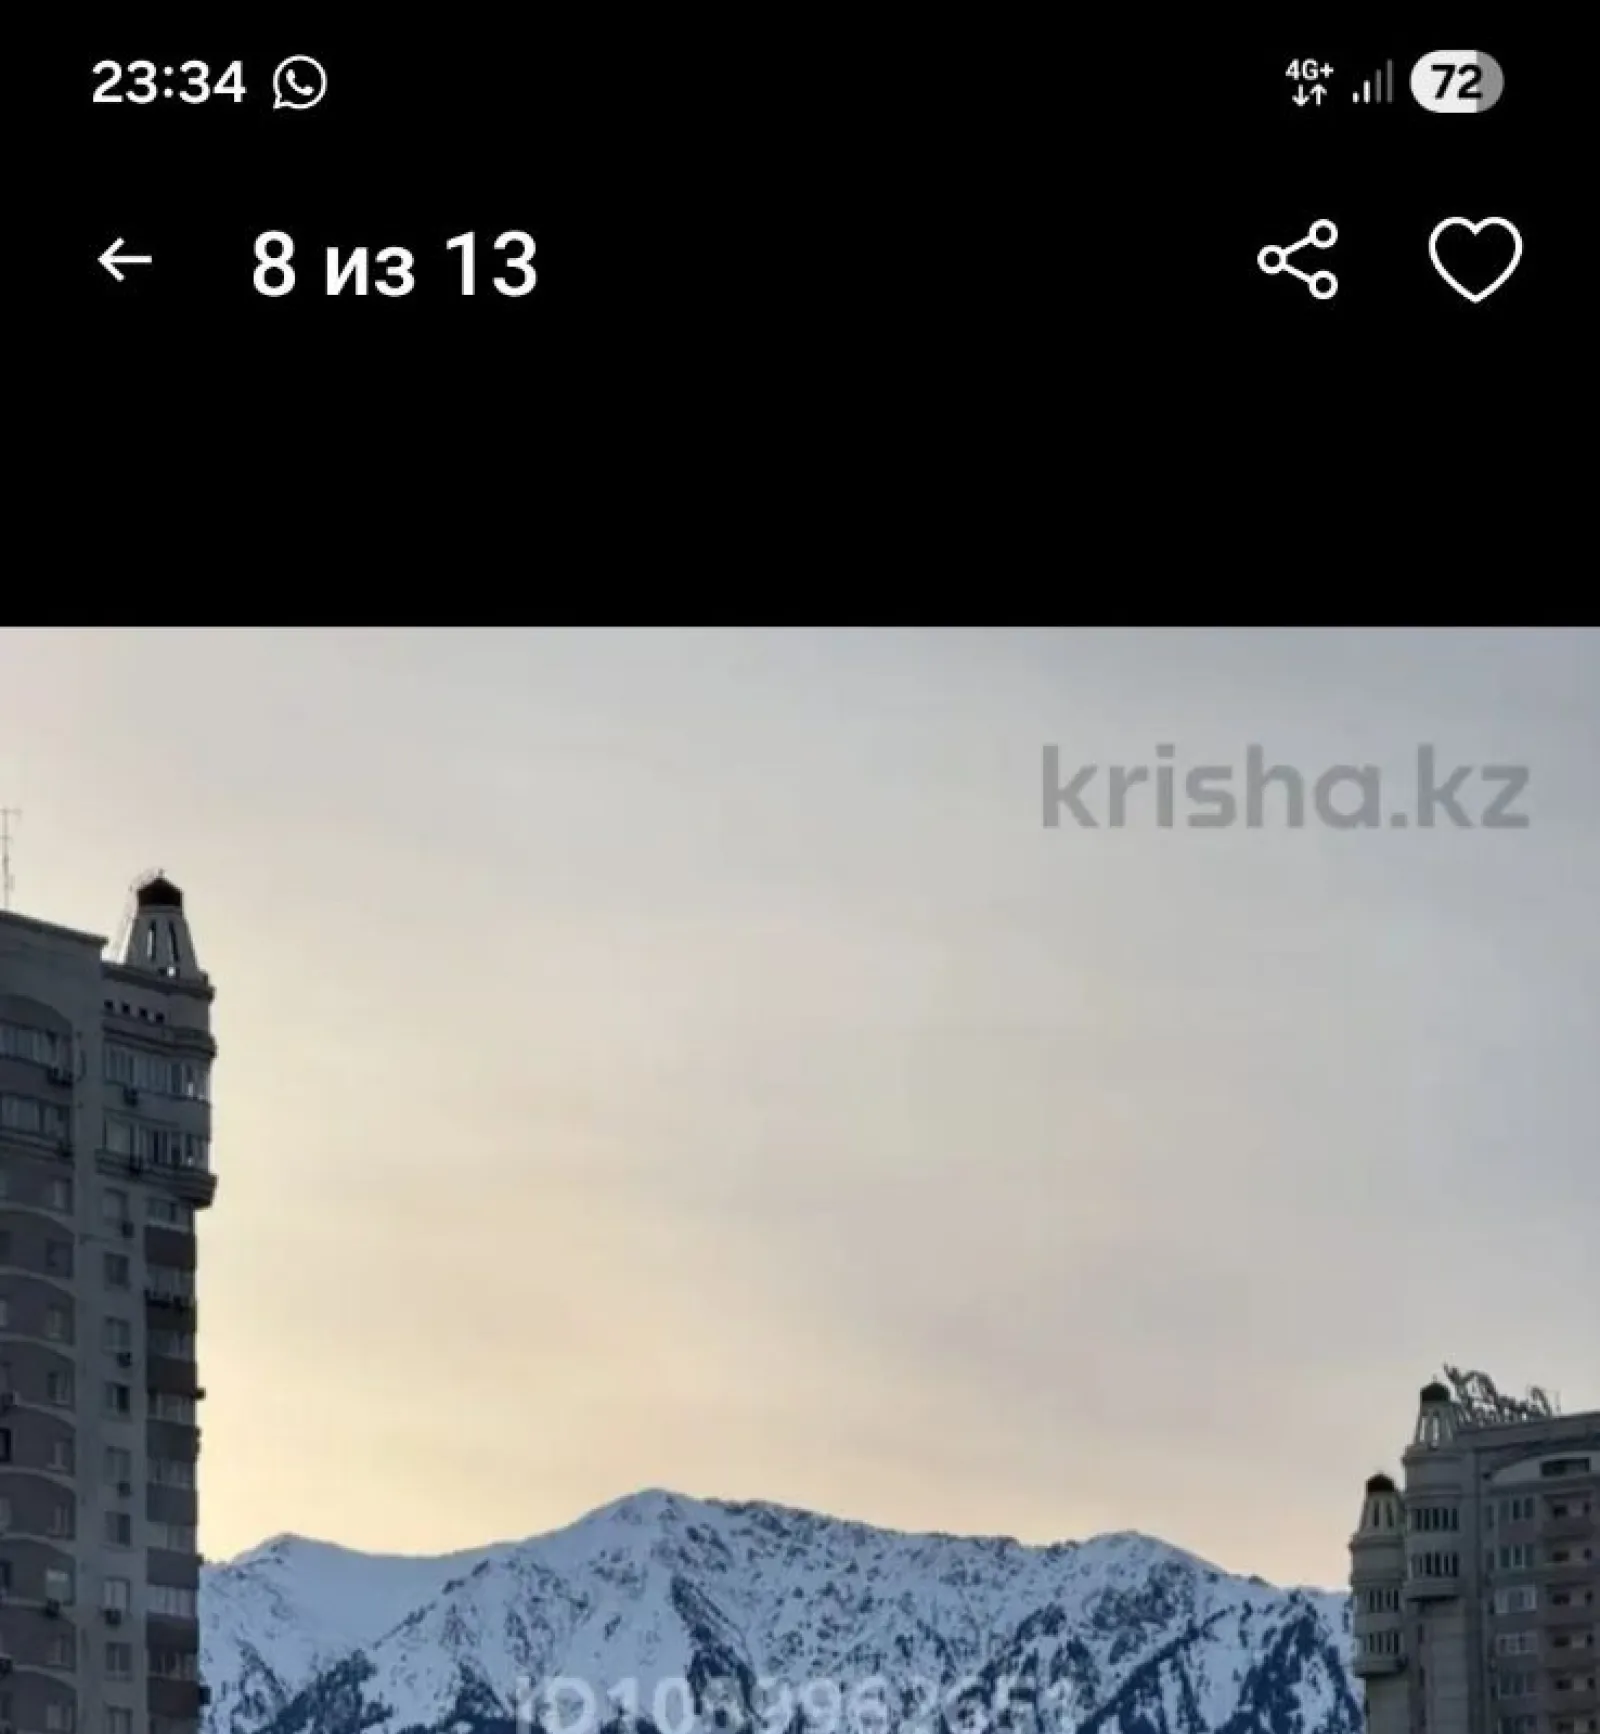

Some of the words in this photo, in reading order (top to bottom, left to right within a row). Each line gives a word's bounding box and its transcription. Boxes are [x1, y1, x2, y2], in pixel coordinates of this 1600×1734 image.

[92, 59, 247, 105] 23:34
[1285, 58, 1334, 81] 4G+
[1431, 64, 1482, 99] 72
[253, 229, 296, 298] 8
[326, 246, 415, 298] из
[446, 229, 537, 298] 13
